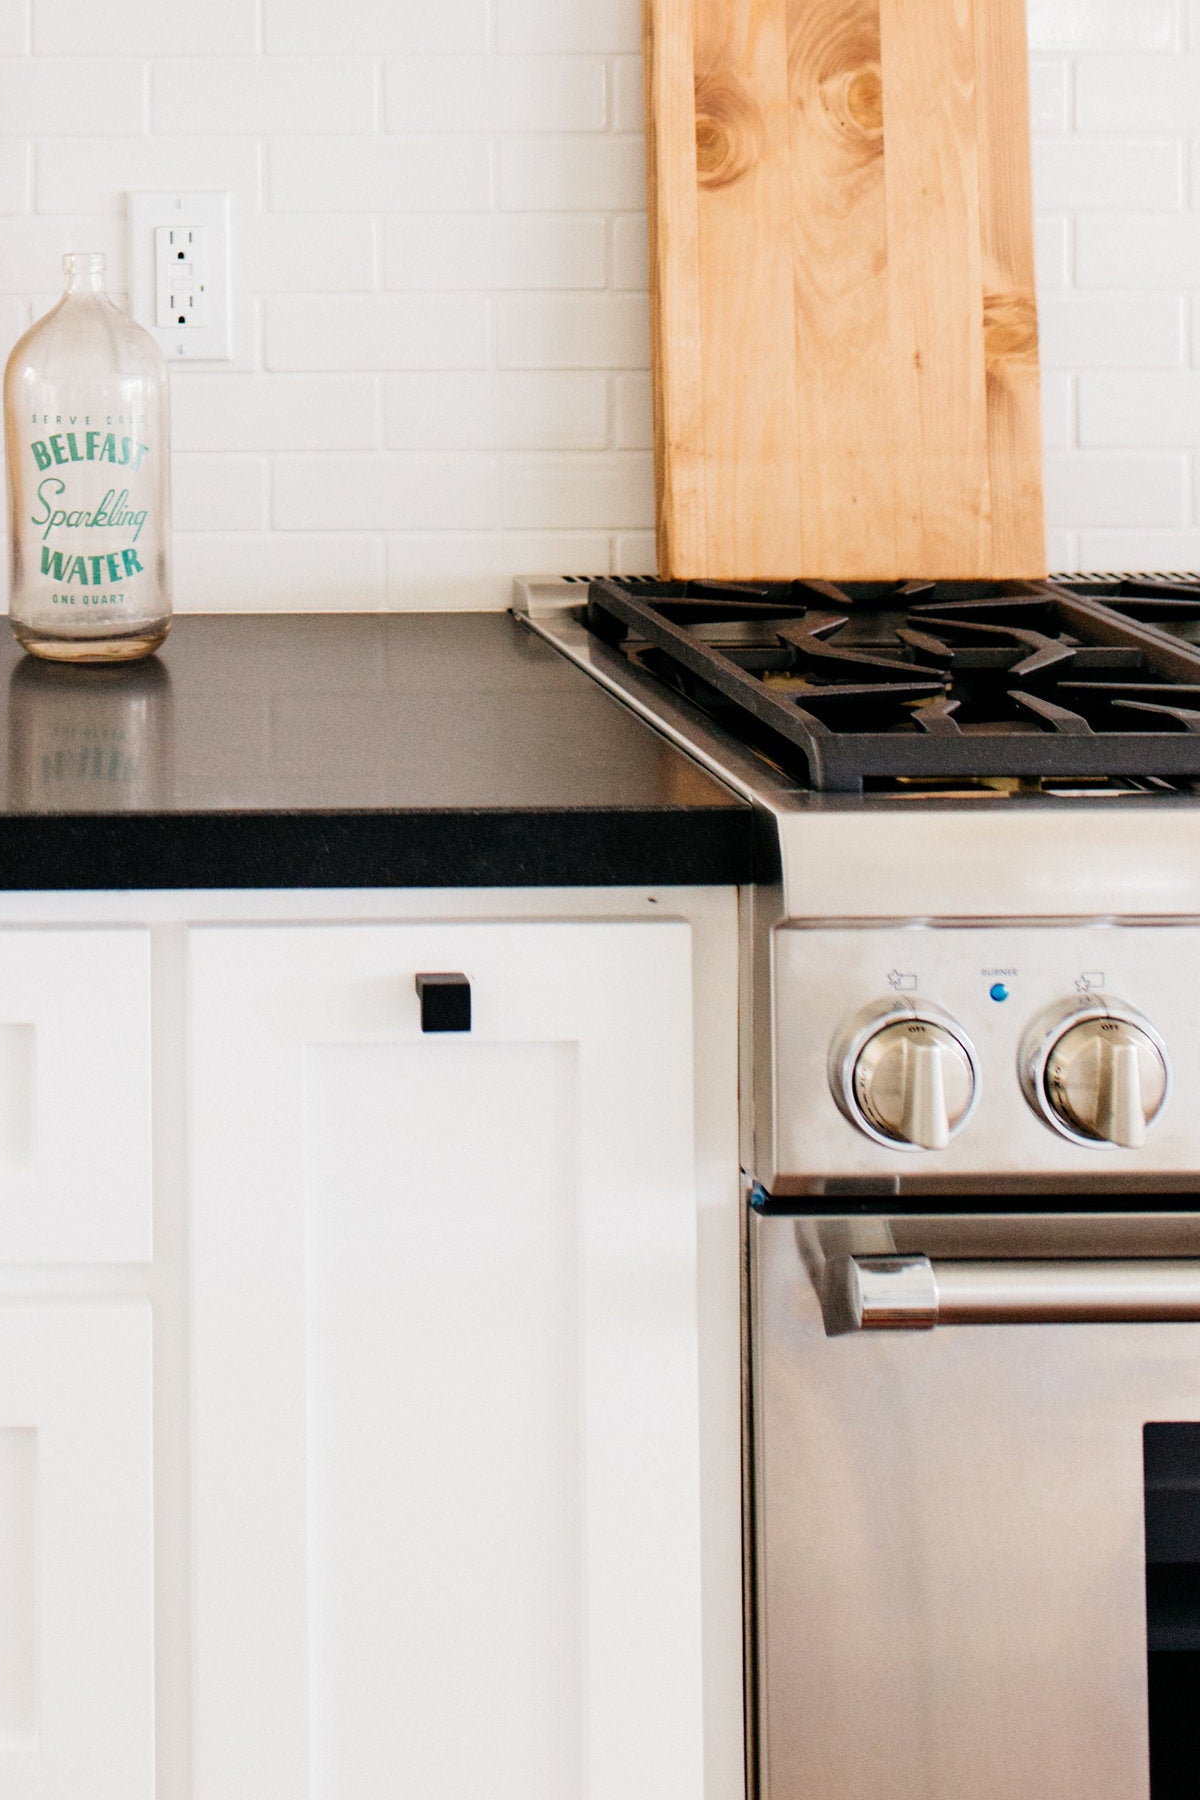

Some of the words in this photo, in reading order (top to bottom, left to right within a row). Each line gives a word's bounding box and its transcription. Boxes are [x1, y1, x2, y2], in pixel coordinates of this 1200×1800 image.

[31, 414, 90, 425] SERVE
[30, 431, 149, 472] BELFAST
[31, 477, 148, 542] Sparkling
[41, 545, 144, 585] WATER
[52, 594, 76, 604] ONE
[82, 594, 125, 605] QUART
